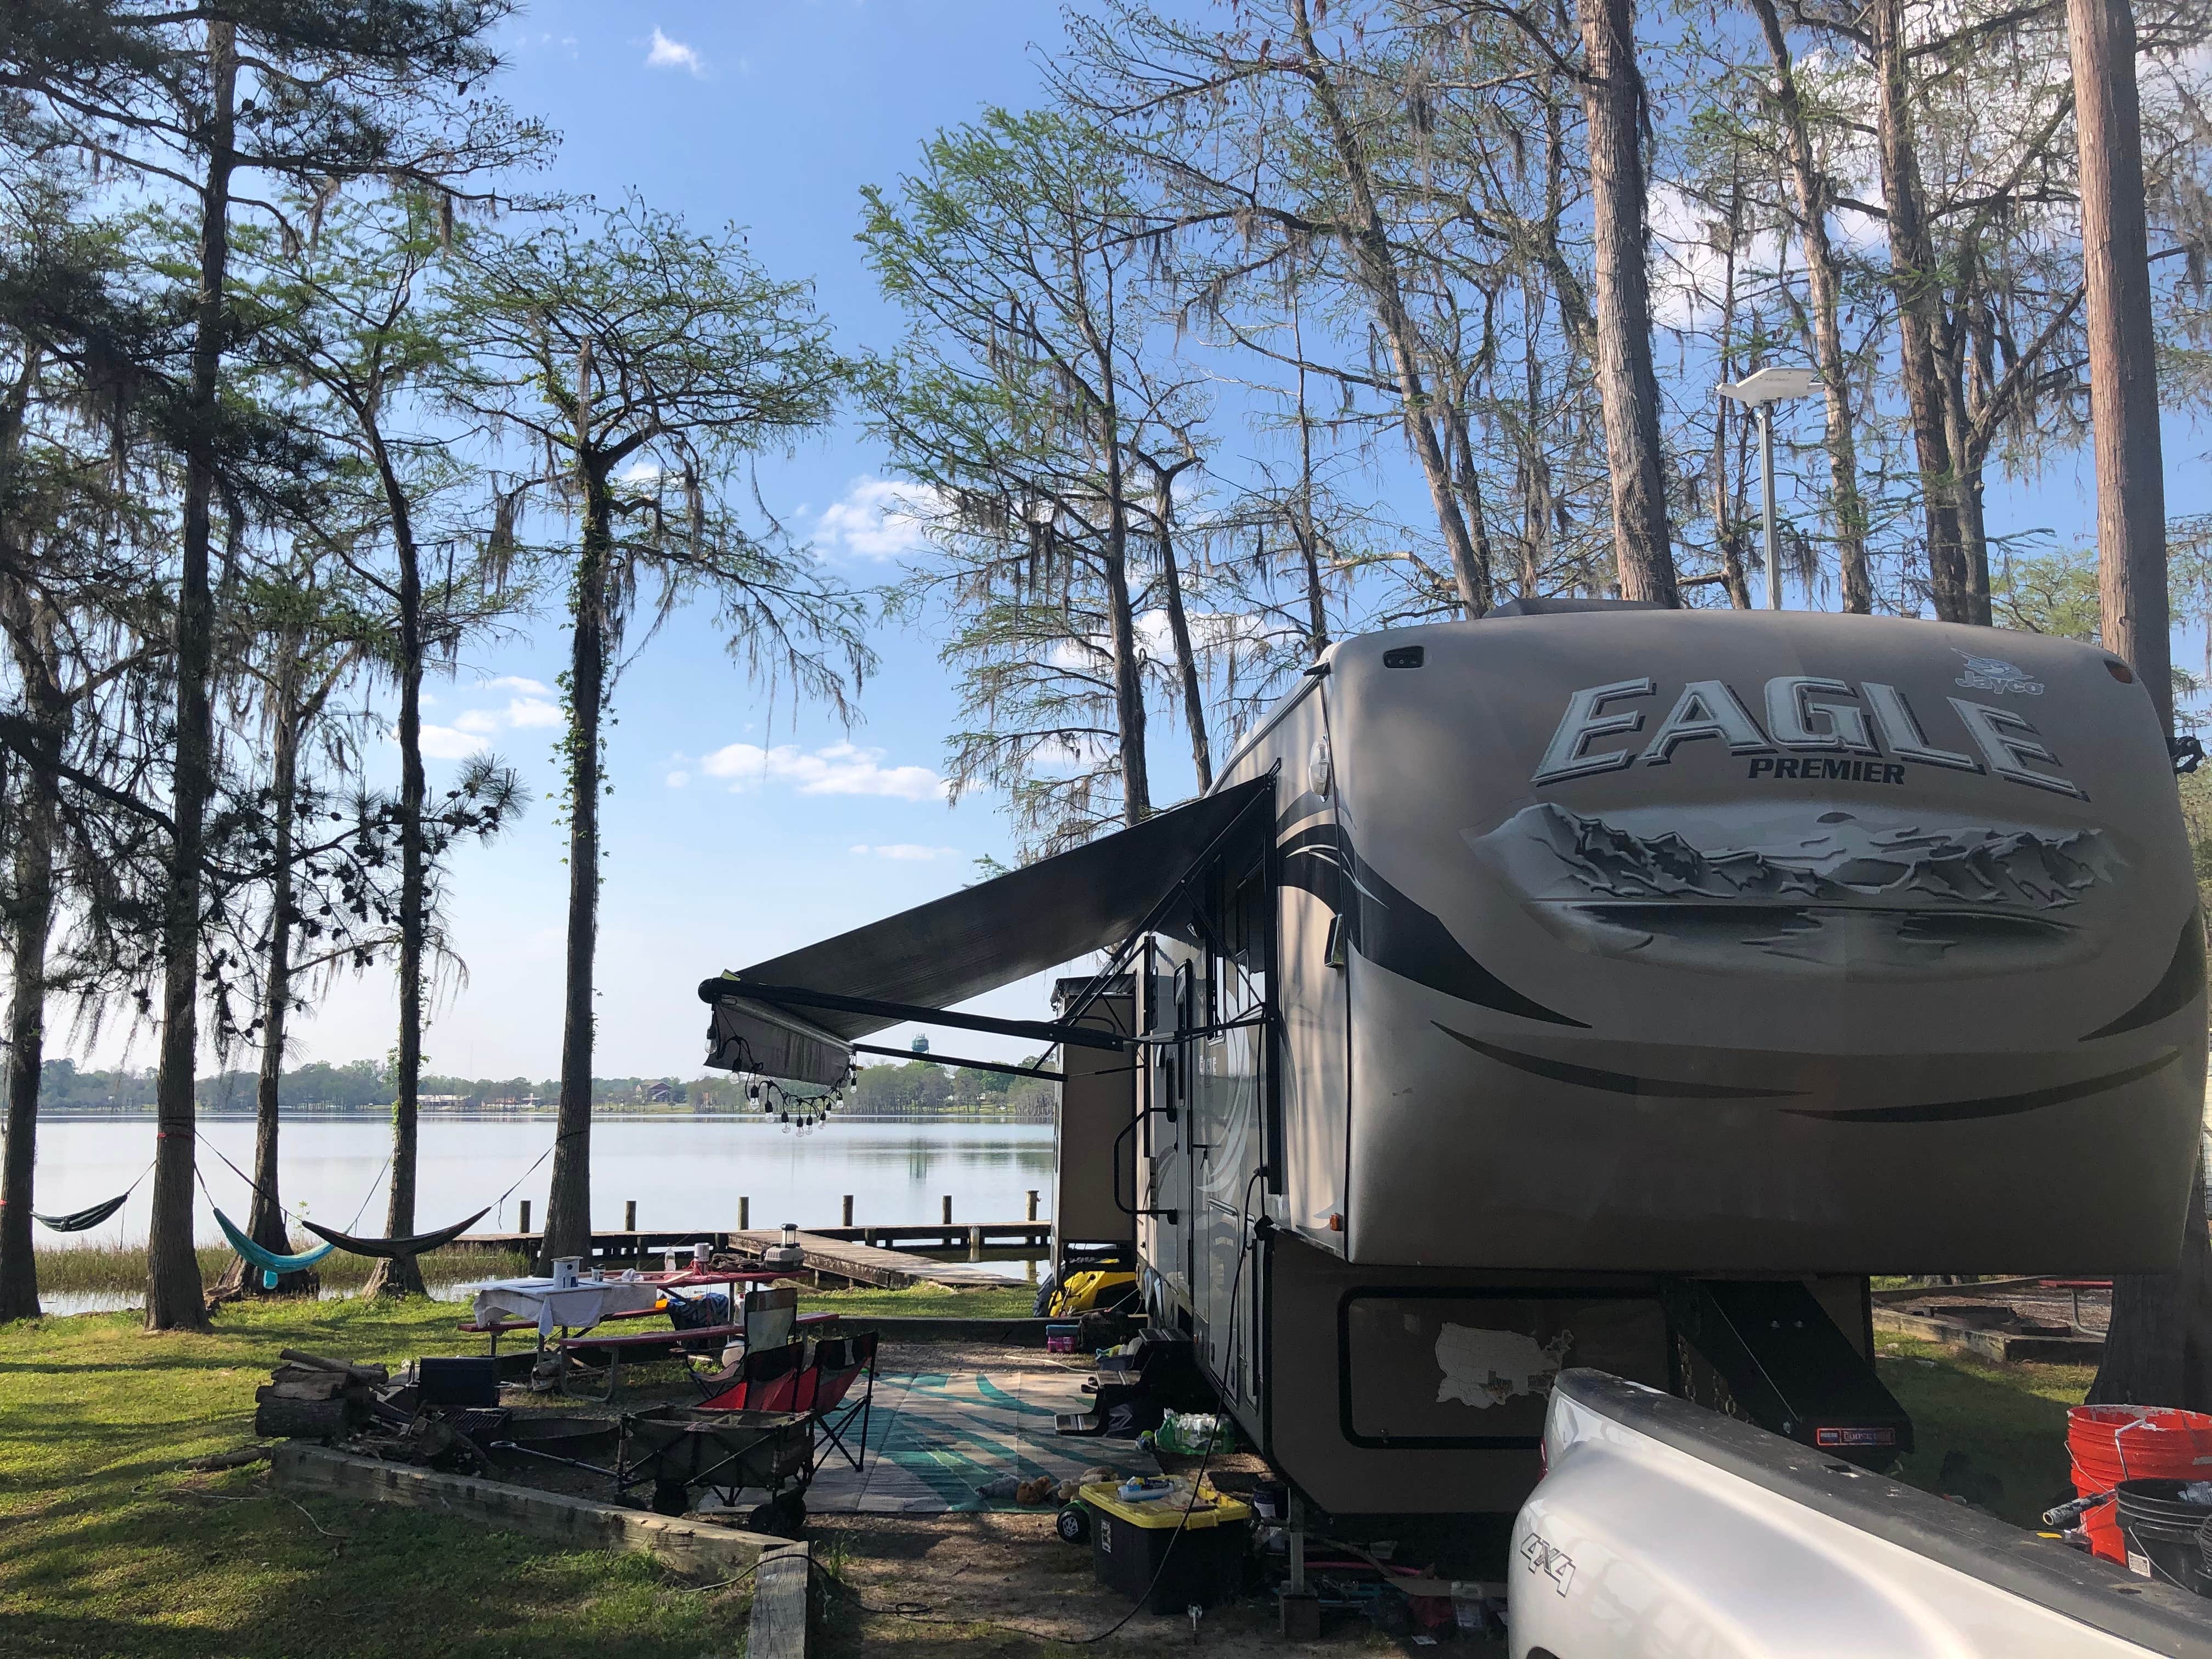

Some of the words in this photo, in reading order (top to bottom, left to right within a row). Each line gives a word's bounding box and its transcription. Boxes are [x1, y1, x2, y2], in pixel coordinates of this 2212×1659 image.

[1955, 670, 2043, 696] Jayco
[1530, 676, 2090, 802] EAGLE
[1748, 758, 1905, 785] PREMIER
